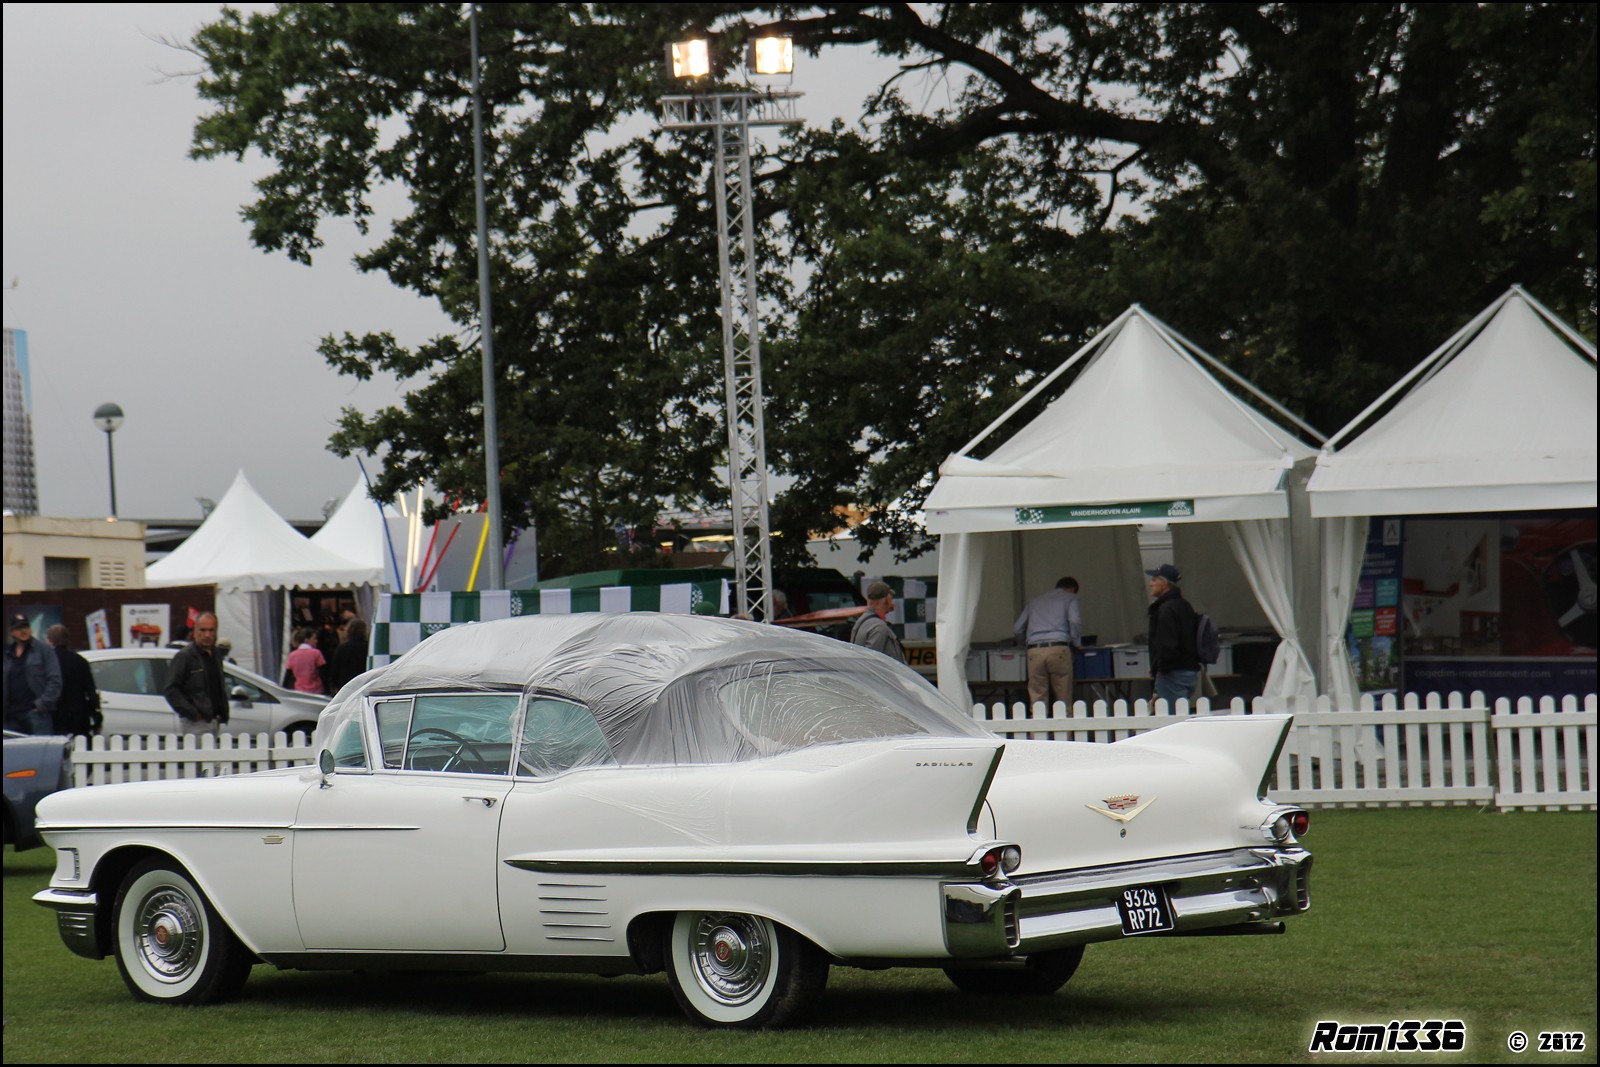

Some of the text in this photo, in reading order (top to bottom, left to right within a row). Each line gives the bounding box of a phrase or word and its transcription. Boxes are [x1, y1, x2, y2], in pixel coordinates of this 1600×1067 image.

[1070, 509, 1121, 517] VANDERHOEVEN
[908, 648, 937, 666] He
[1128, 907, 1163, 930] RP72
